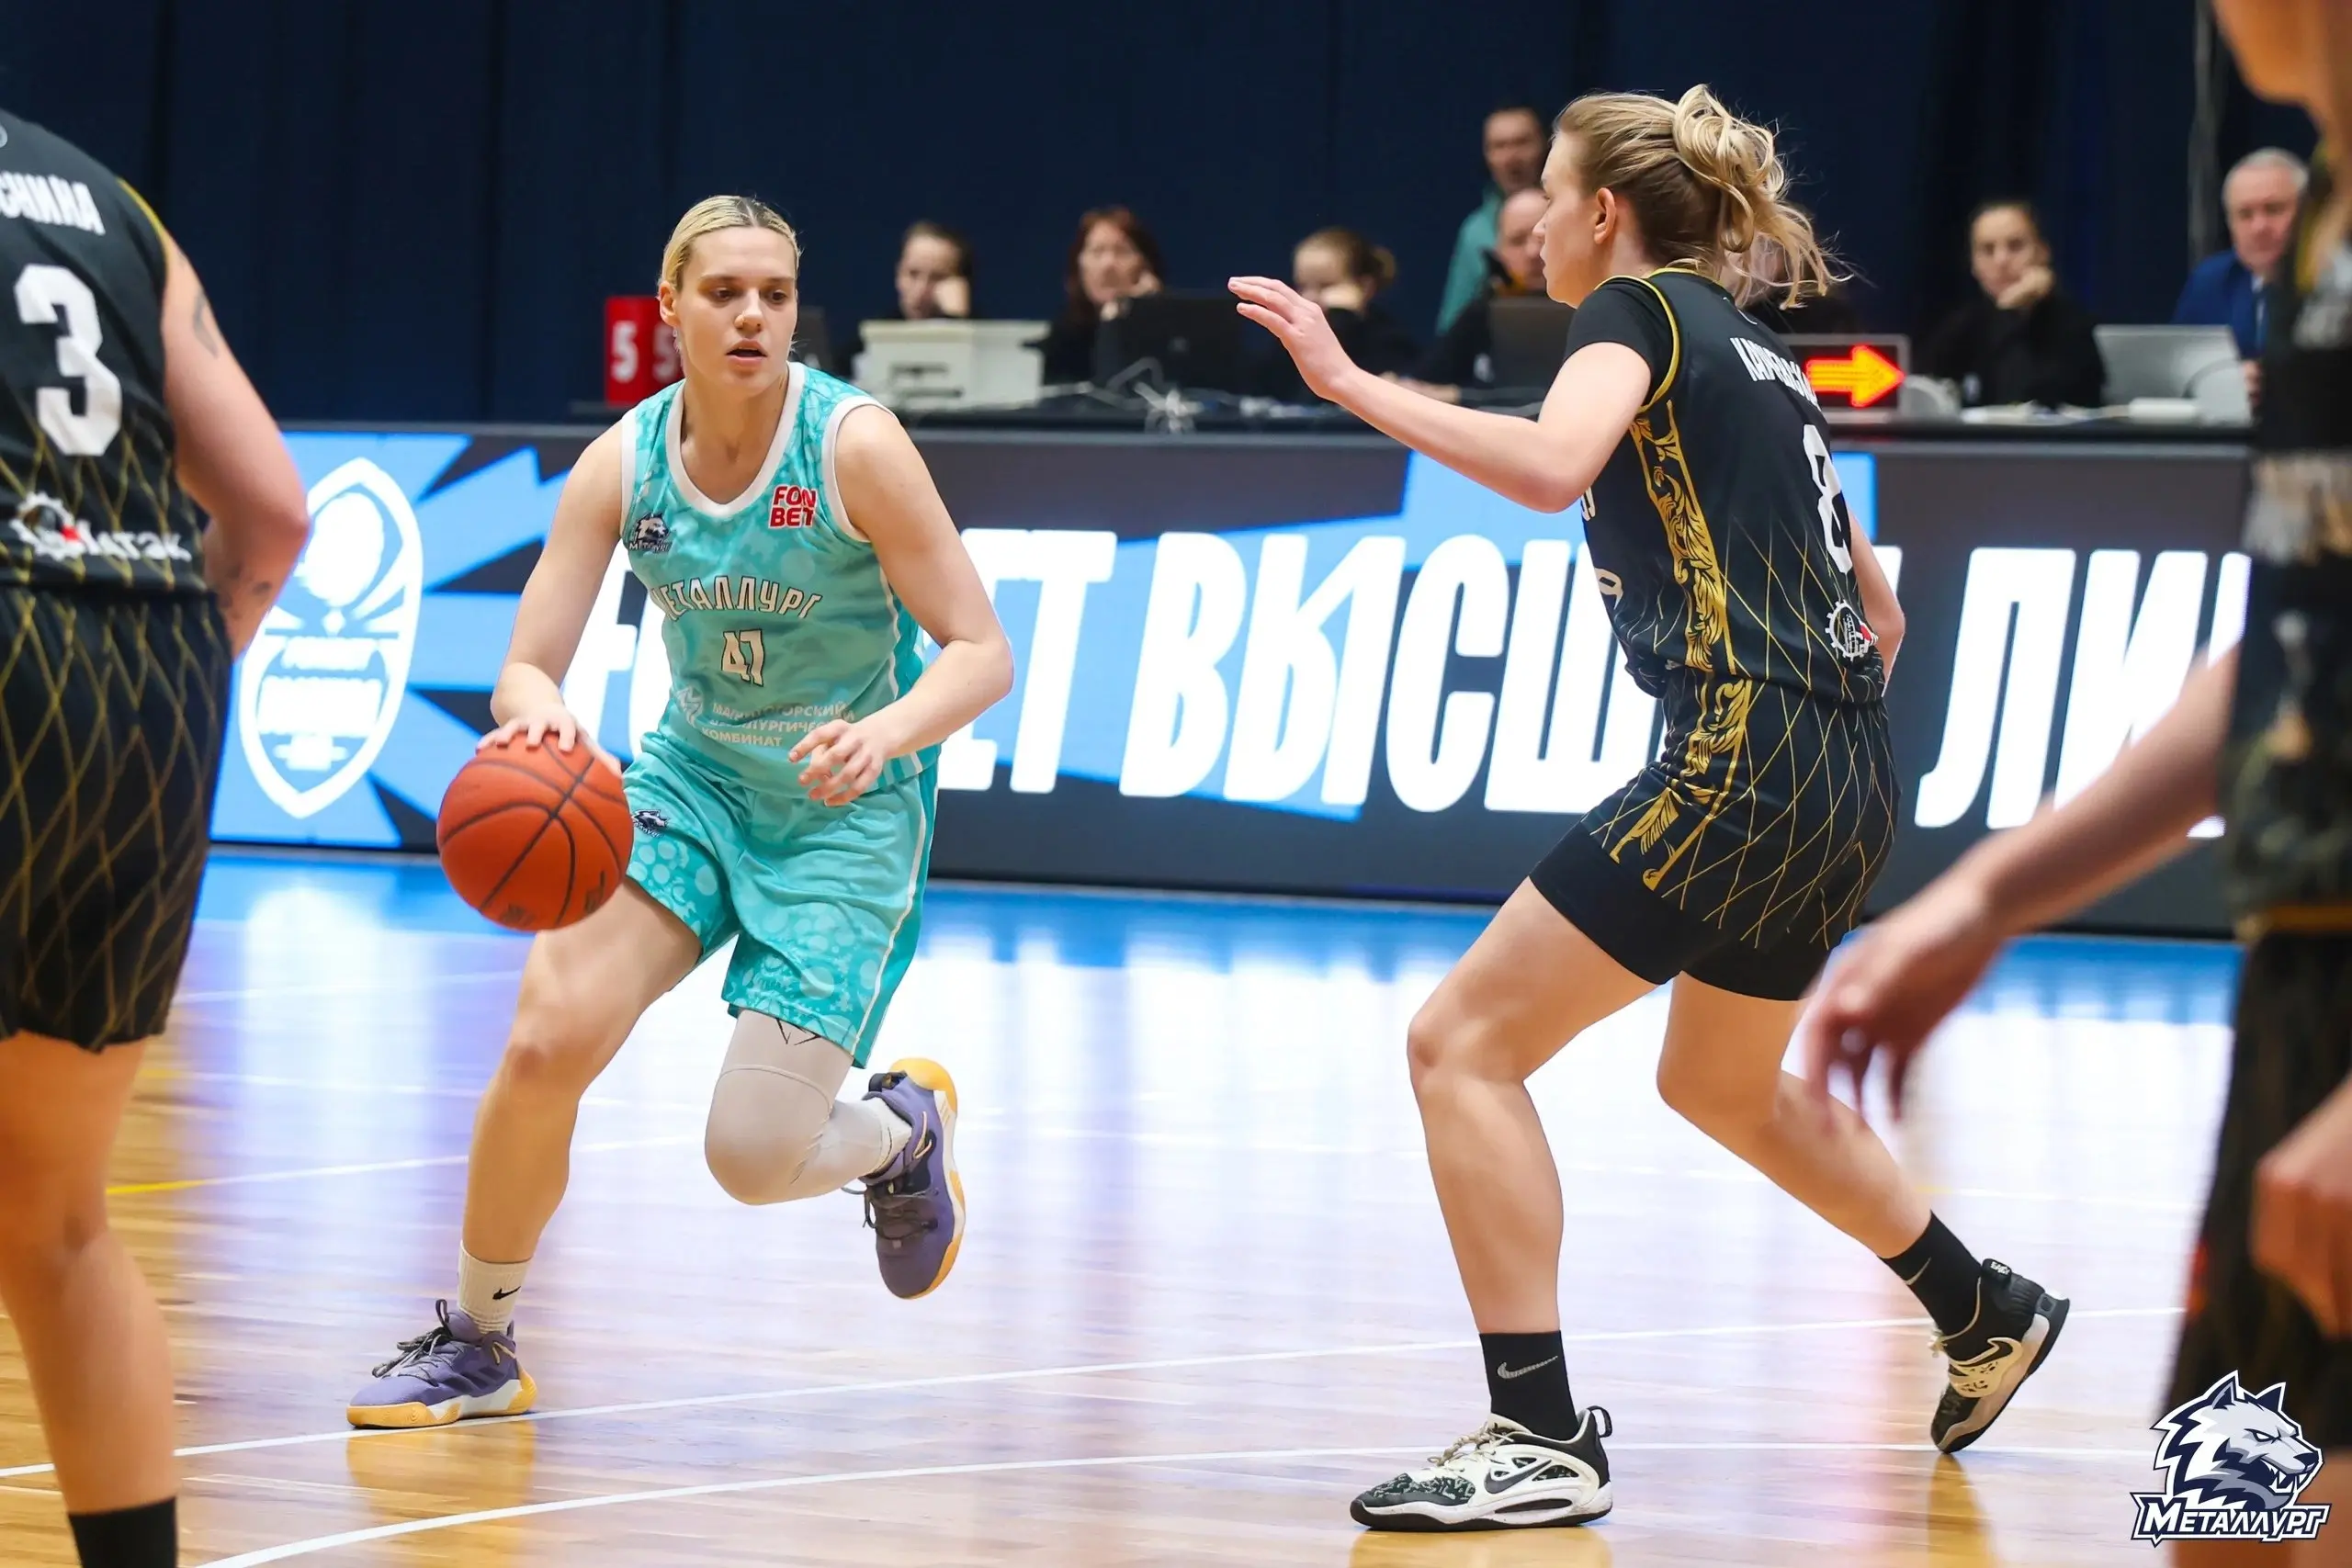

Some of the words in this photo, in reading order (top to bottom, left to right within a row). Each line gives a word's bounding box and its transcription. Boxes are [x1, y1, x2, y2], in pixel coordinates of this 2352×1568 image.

[14, 264, 121, 457] 3
[611, 320, 639, 384] 5
[768, 506, 815, 528] BET
[772, 484, 818, 509] FON
[1803, 423, 1853, 574] 8
[721, 628, 764, 687] 47
[702, 727, 783, 747] КОМБИНАТ
